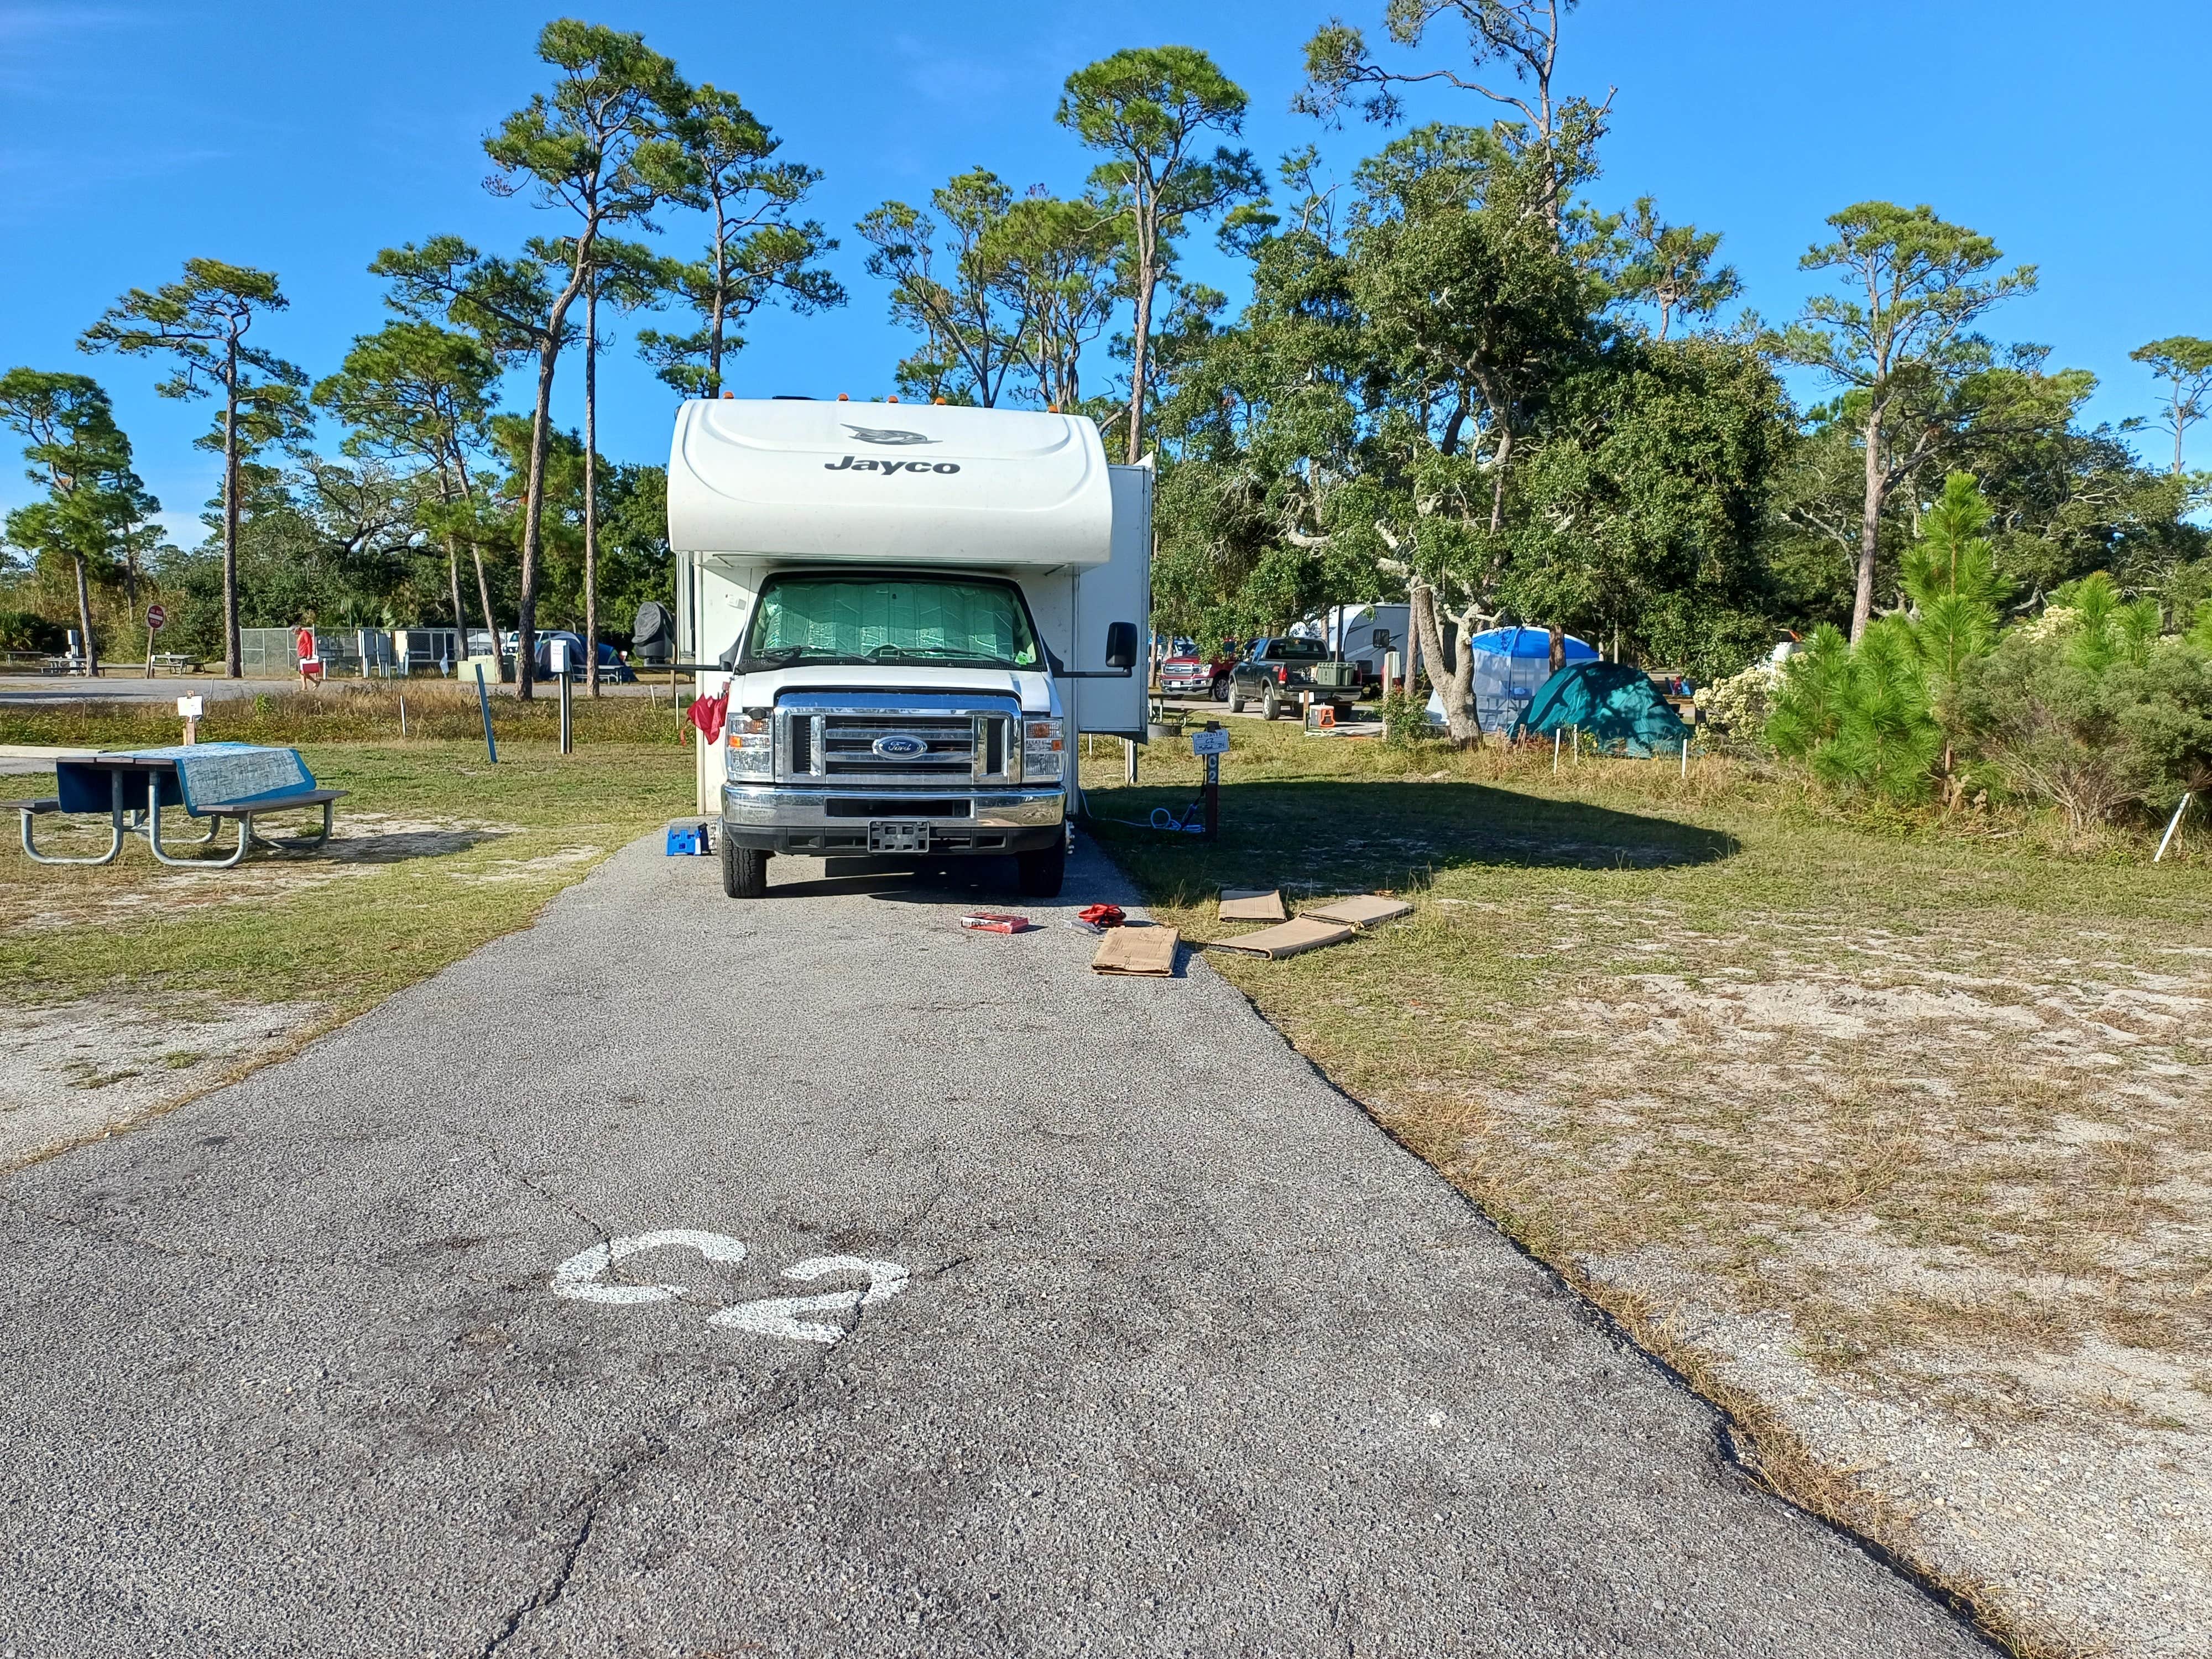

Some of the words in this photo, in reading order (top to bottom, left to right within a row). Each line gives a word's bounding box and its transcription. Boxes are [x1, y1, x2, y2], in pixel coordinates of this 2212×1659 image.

[824, 456, 961, 476] Jayco
[888, 741, 912, 751] Ford
[552, 1228, 911, 1344] C2
